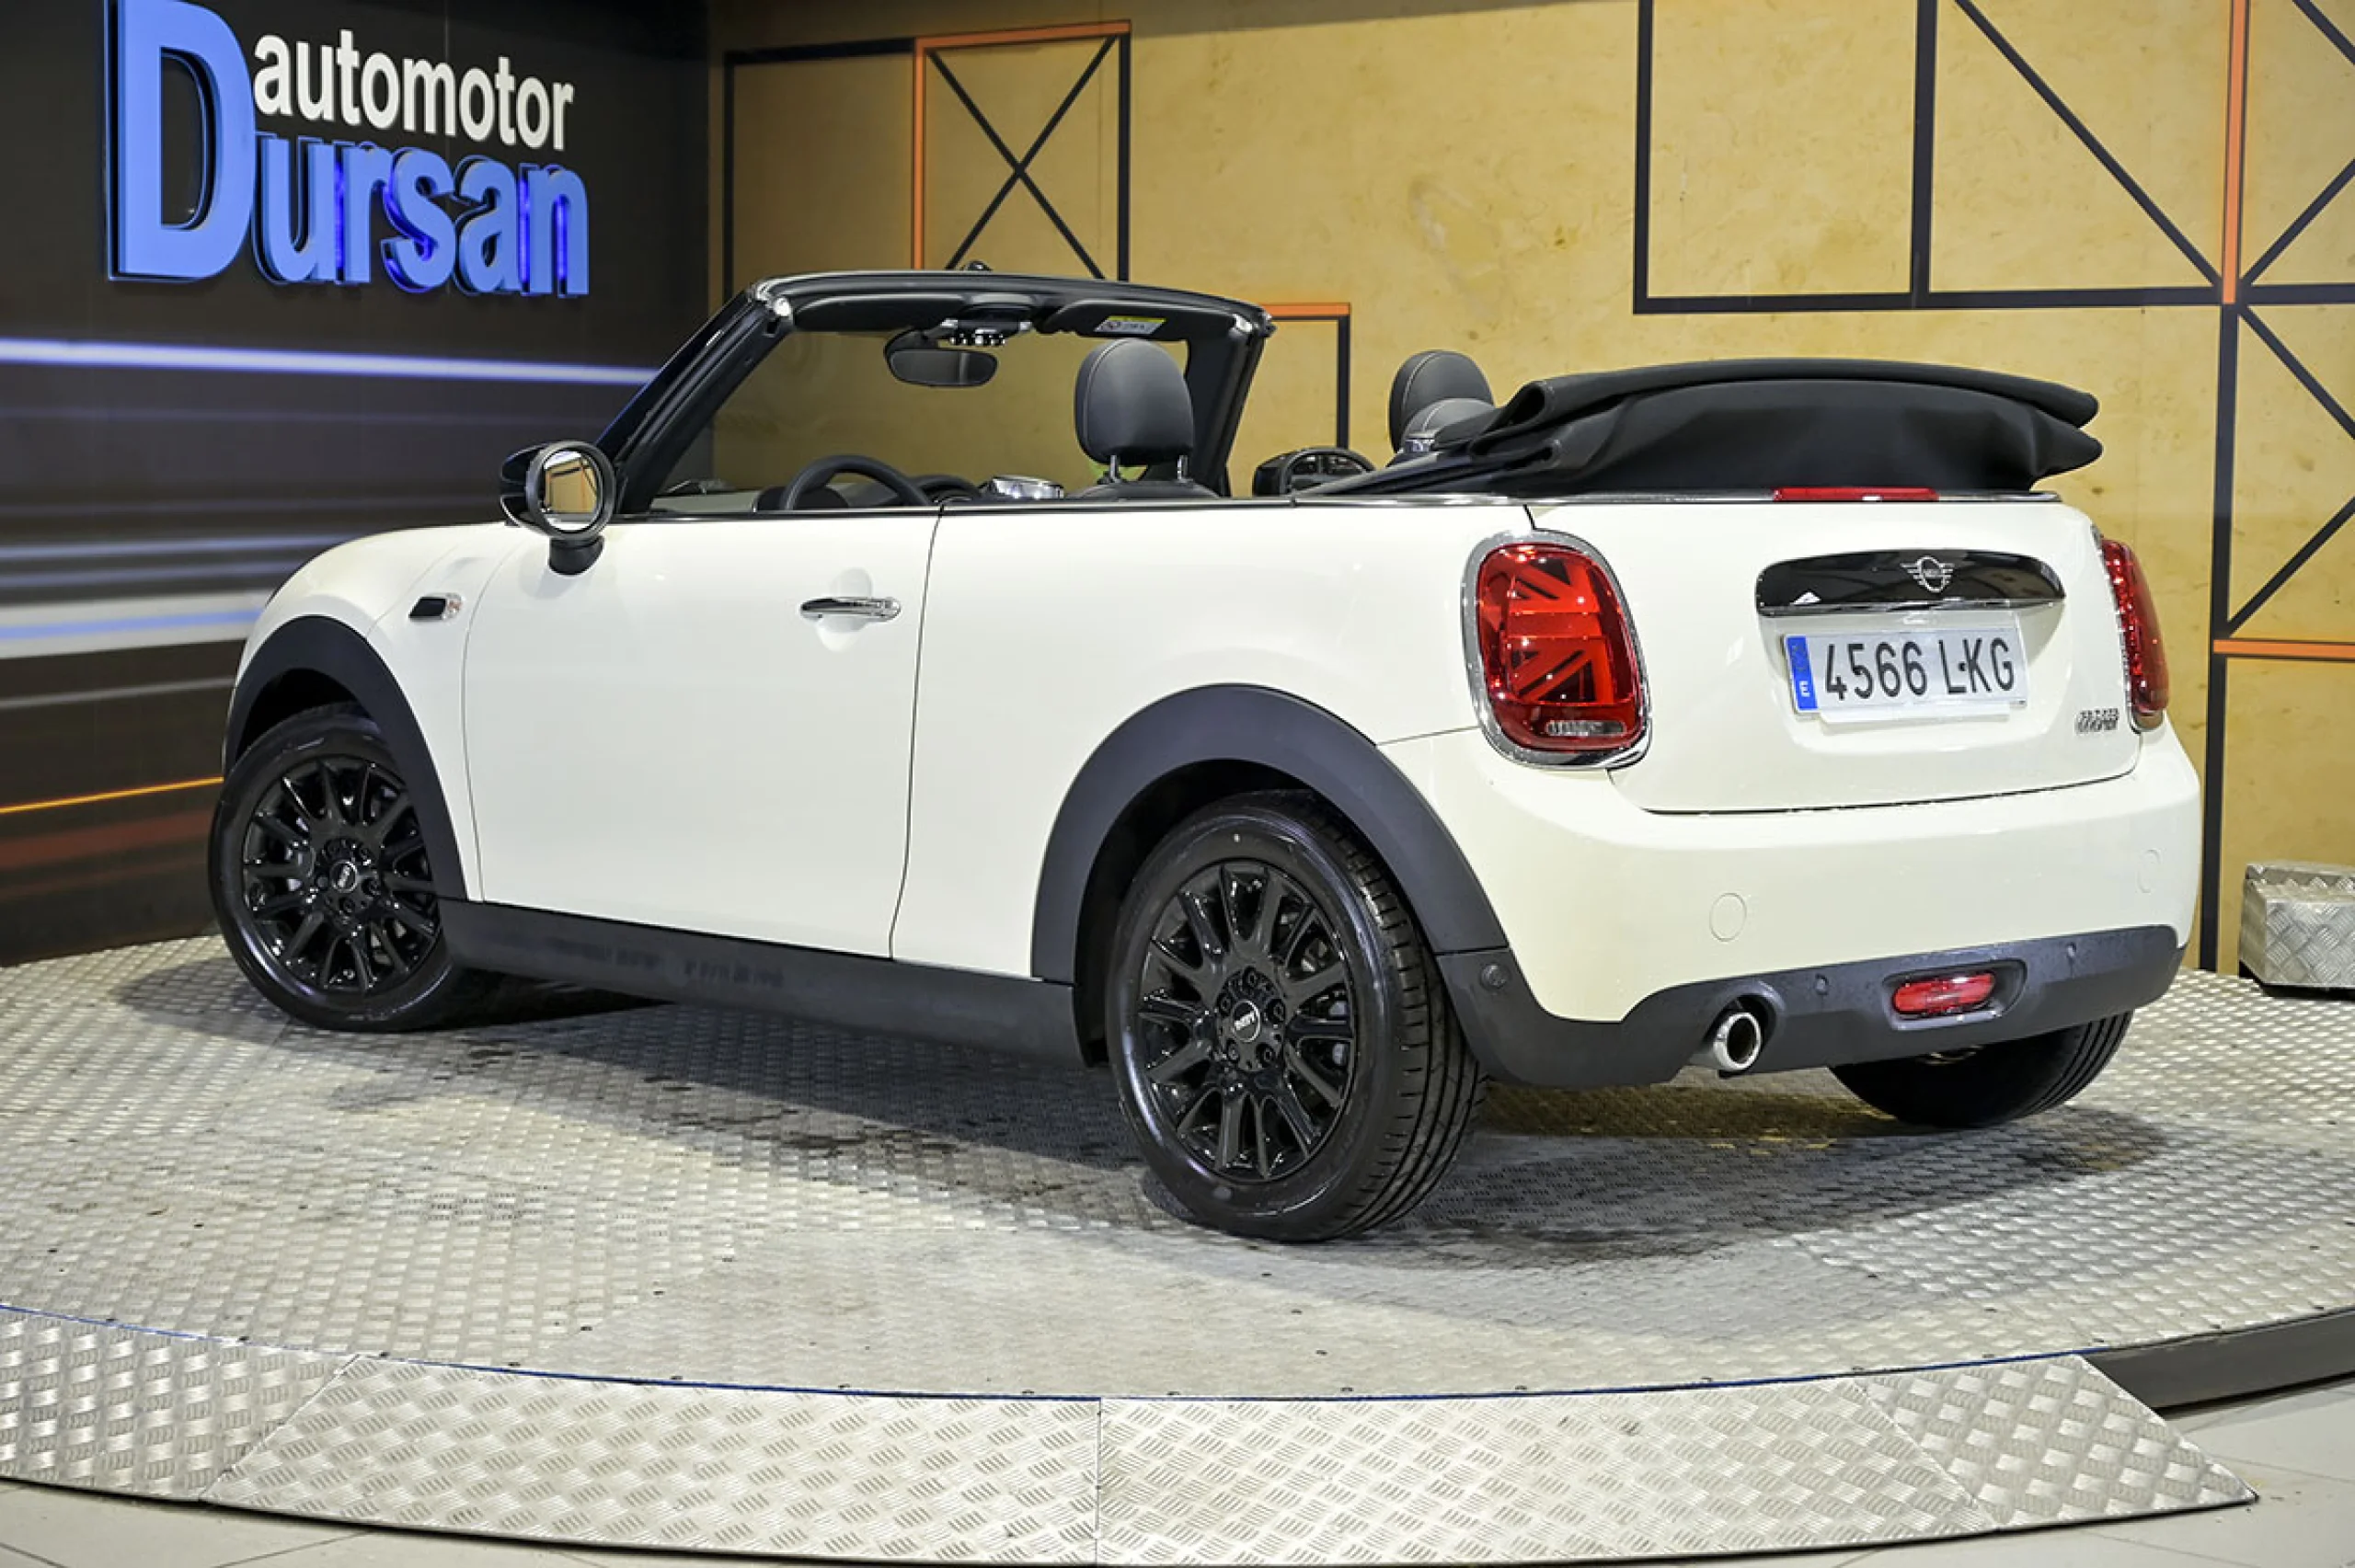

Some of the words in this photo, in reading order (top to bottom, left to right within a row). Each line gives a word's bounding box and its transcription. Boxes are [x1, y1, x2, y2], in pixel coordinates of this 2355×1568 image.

[254, 29, 574, 152] automotor
[105, 0, 590, 296] Dursan
[1798, 680, 1810, 698] E
[1825, 640, 1927, 701] 4566
[1938, 637, 2015, 694] LKG
